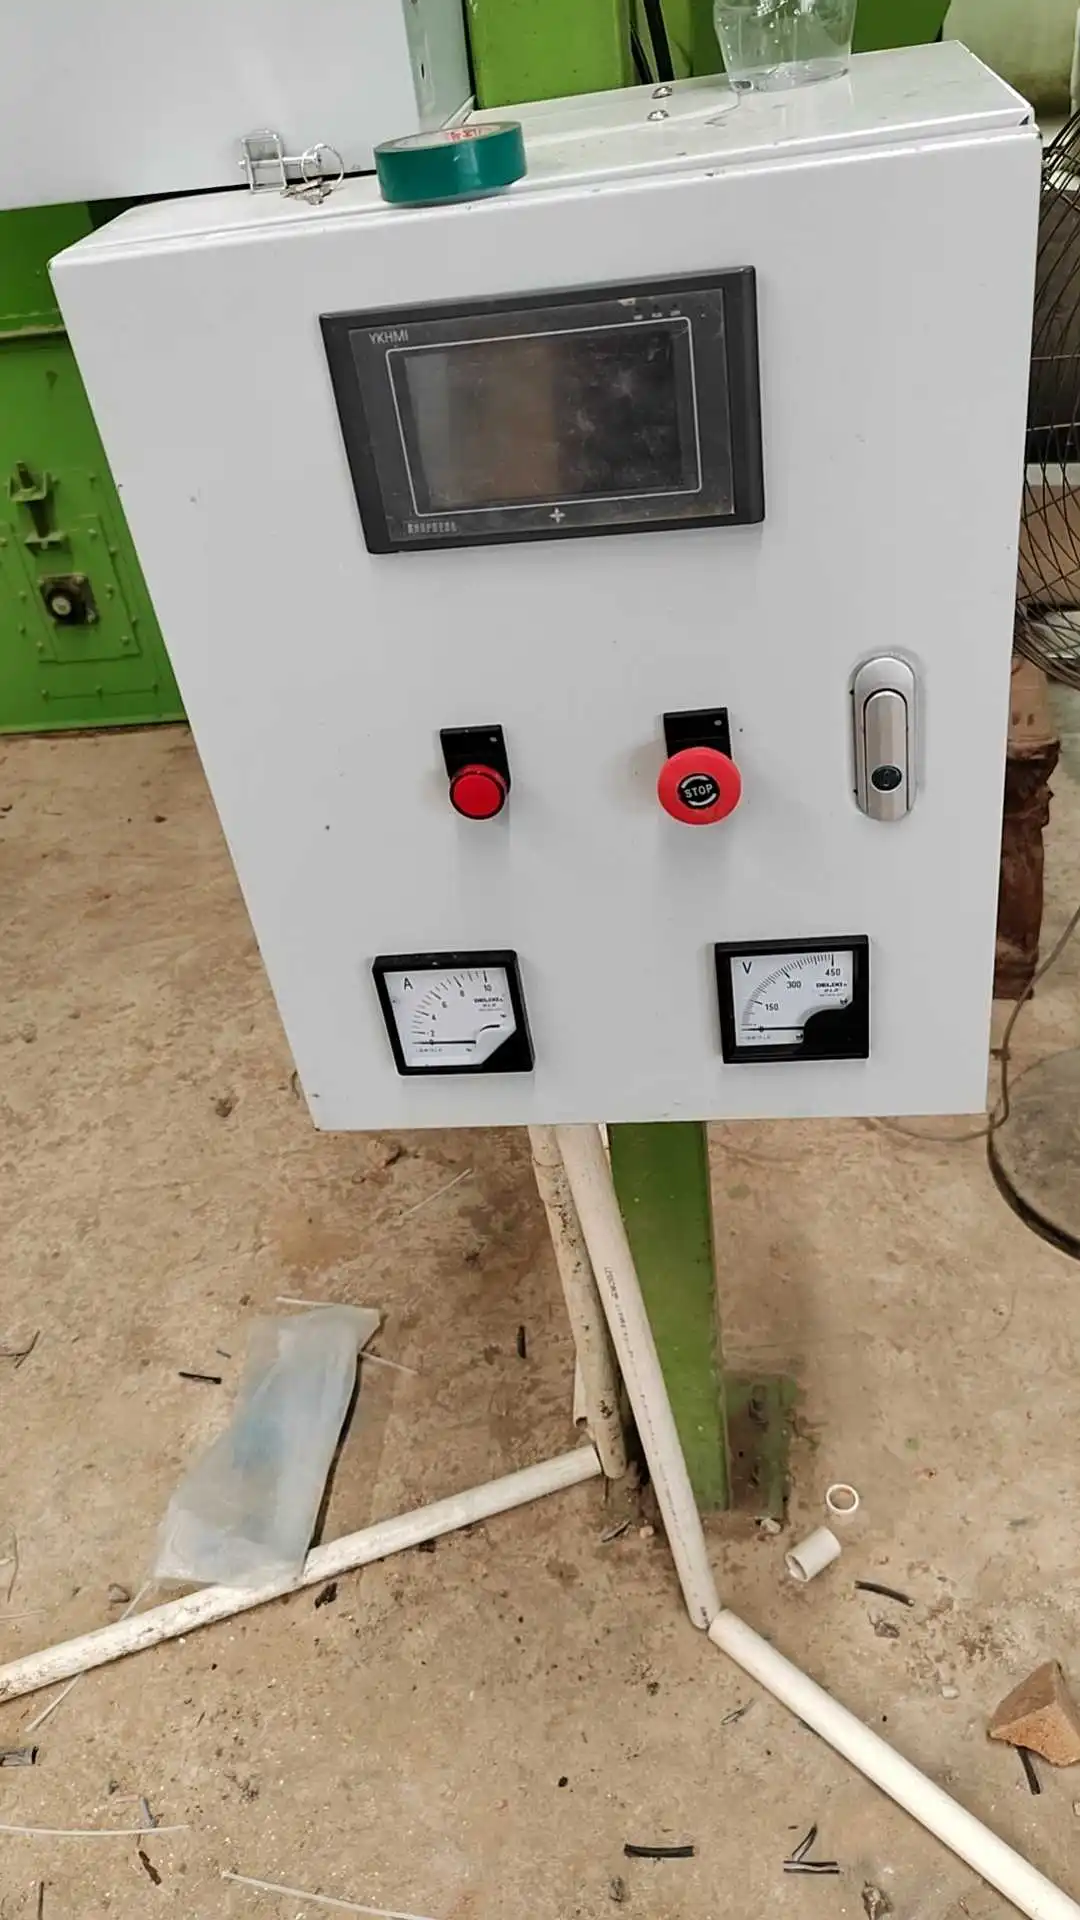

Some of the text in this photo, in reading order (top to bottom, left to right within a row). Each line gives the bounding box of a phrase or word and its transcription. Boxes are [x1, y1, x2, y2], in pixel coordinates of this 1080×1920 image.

[368, 328, 409, 344] YKHMI
[684, 783, 713, 798] STOP
[742, 961, 752, 974] V
[825, 968, 841, 977] 450
[403, 977, 413, 990] A
[484, 984, 492, 992] 10
[787, 981, 801, 989] 300
[765, 1003, 779, 1012] 150
